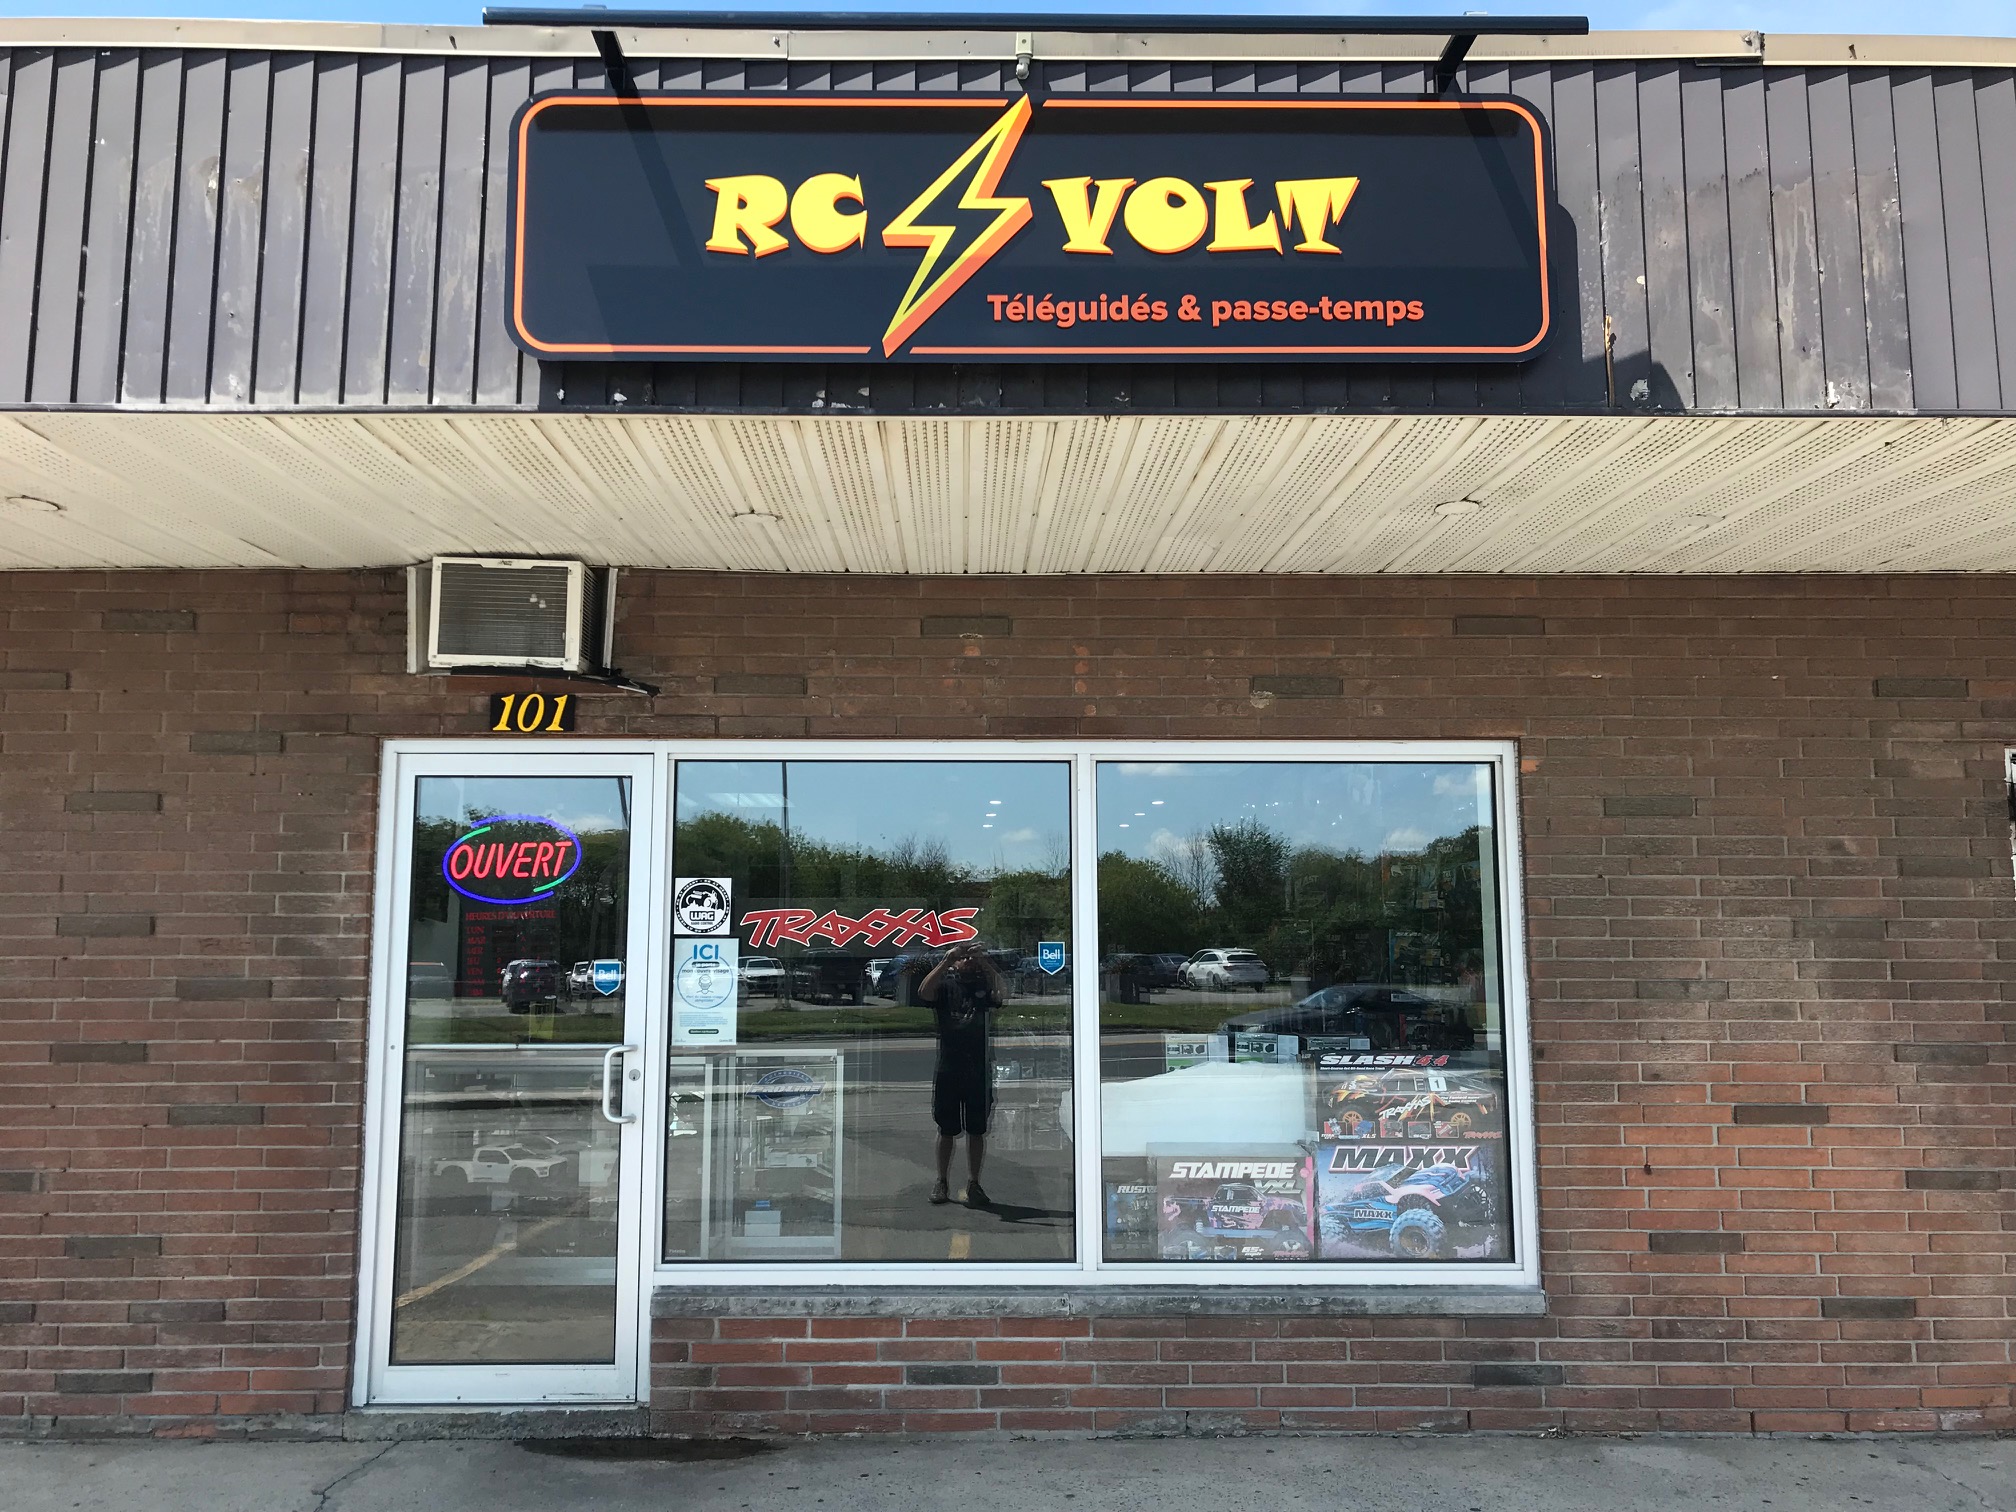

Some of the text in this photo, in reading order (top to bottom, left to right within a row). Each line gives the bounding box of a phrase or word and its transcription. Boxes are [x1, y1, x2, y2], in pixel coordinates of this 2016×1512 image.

[705, 173, 1361, 259] RC VOLT
[986, 293, 1425, 328] Téléguidés & passe-temps
[492, 693, 568, 732] 101
[450, 841, 573, 880] OUVERT
[690, 911, 715, 921] WAG
[740, 908, 980, 948] TRAXXAS
[692, 944, 719, 960] ICI
[1042, 948, 1061, 960] Bell
[597, 969, 618, 980] Bell
[1320, 1054, 1415, 1066] SLASH
[1379, 1096, 1431, 1121] TRAXXAS
[1329, 1145, 1479, 1174] MAXX
[1169, 1162, 1298, 1179] STAMPEDE
[1254, 1180, 1302, 1194] VXL
[1211, 1204, 1261, 1214] STAMPEDE
[1353, 1209, 1393, 1219] MAXX
